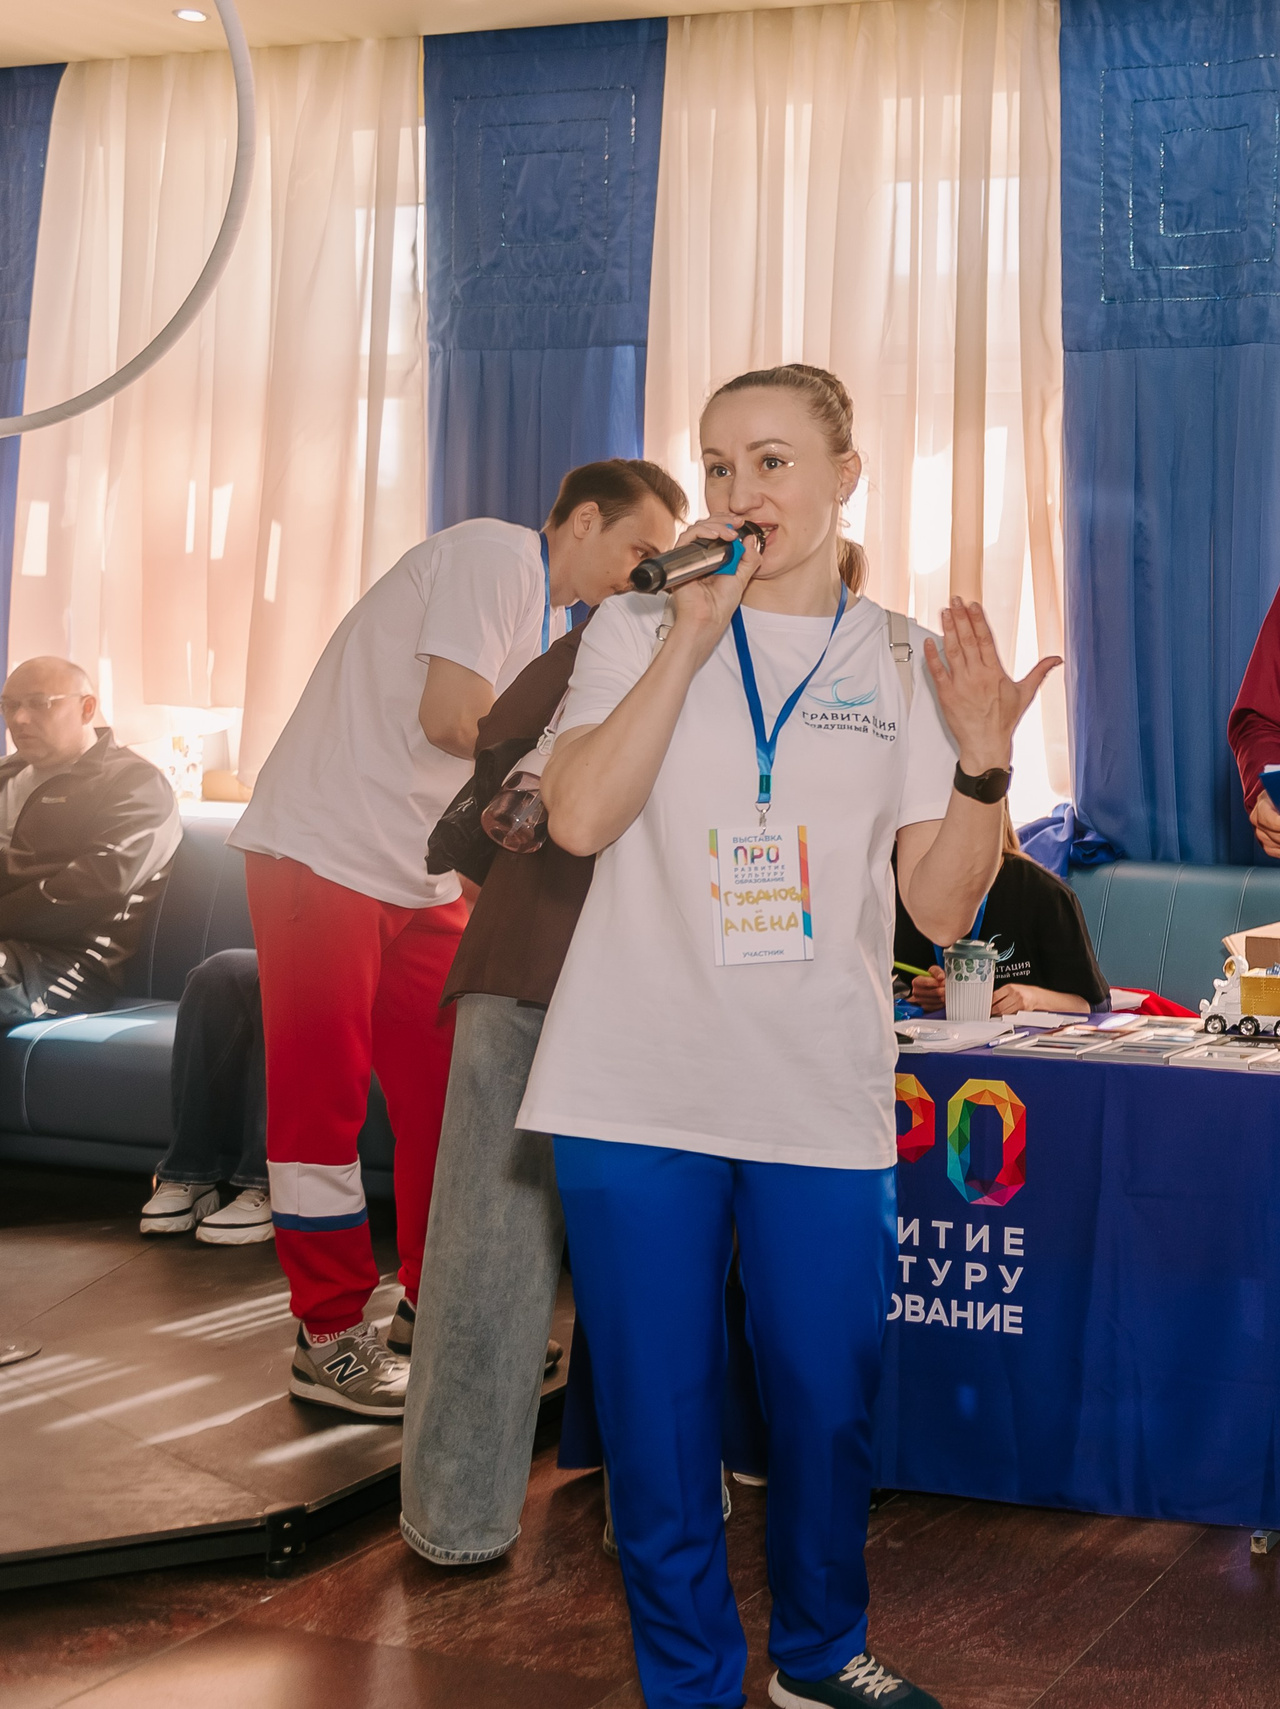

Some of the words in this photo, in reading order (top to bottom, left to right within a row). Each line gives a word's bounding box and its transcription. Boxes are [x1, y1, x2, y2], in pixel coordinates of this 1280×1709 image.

[802, 710, 897, 731] ГРАВИТАЦИЯ
[732, 834, 783, 844] ВЫСТАВКА
[733, 844, 780, 866] ПРО
[734, 864, 786, 873] РАЗВИТИЕ
[734, 871, 785, 879] КУЛЬТУРУ
[734, 877, 785, 885] ОБРАЗОВАНИЕ
[724, 909, 799, 936] АЛЁНА
[742, 949, 785, 958] УЧАСТНИК
[897, 1254, 1024, 1294] ТУРУ
[323, 1351, 369, 1387] N
